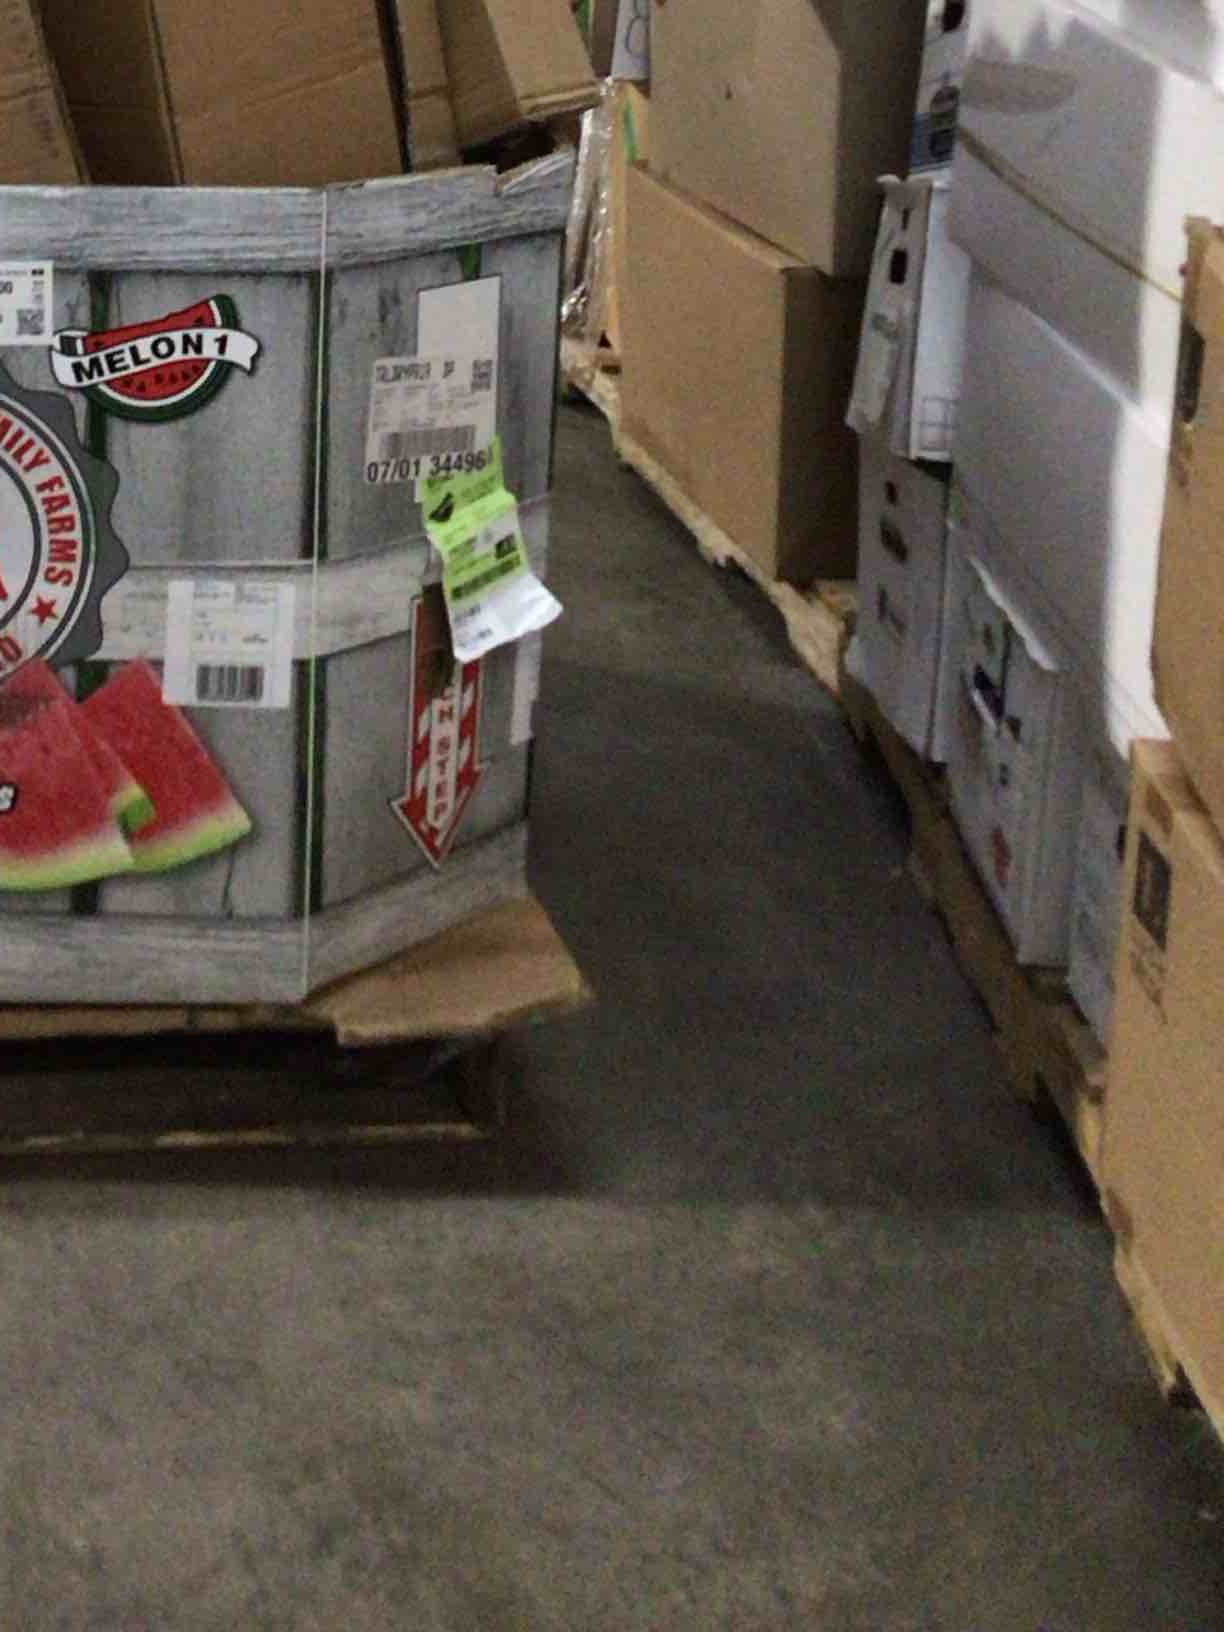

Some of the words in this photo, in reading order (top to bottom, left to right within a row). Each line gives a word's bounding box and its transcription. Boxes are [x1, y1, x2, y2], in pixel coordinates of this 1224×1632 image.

[71, 332, 204, 384] MELON
[213, 334, 228, 356] 1
[367, 458, 421, 483] 07/01
[429, 449, 487, 476] 34496
[36, 475, 80, 588] FARMS
